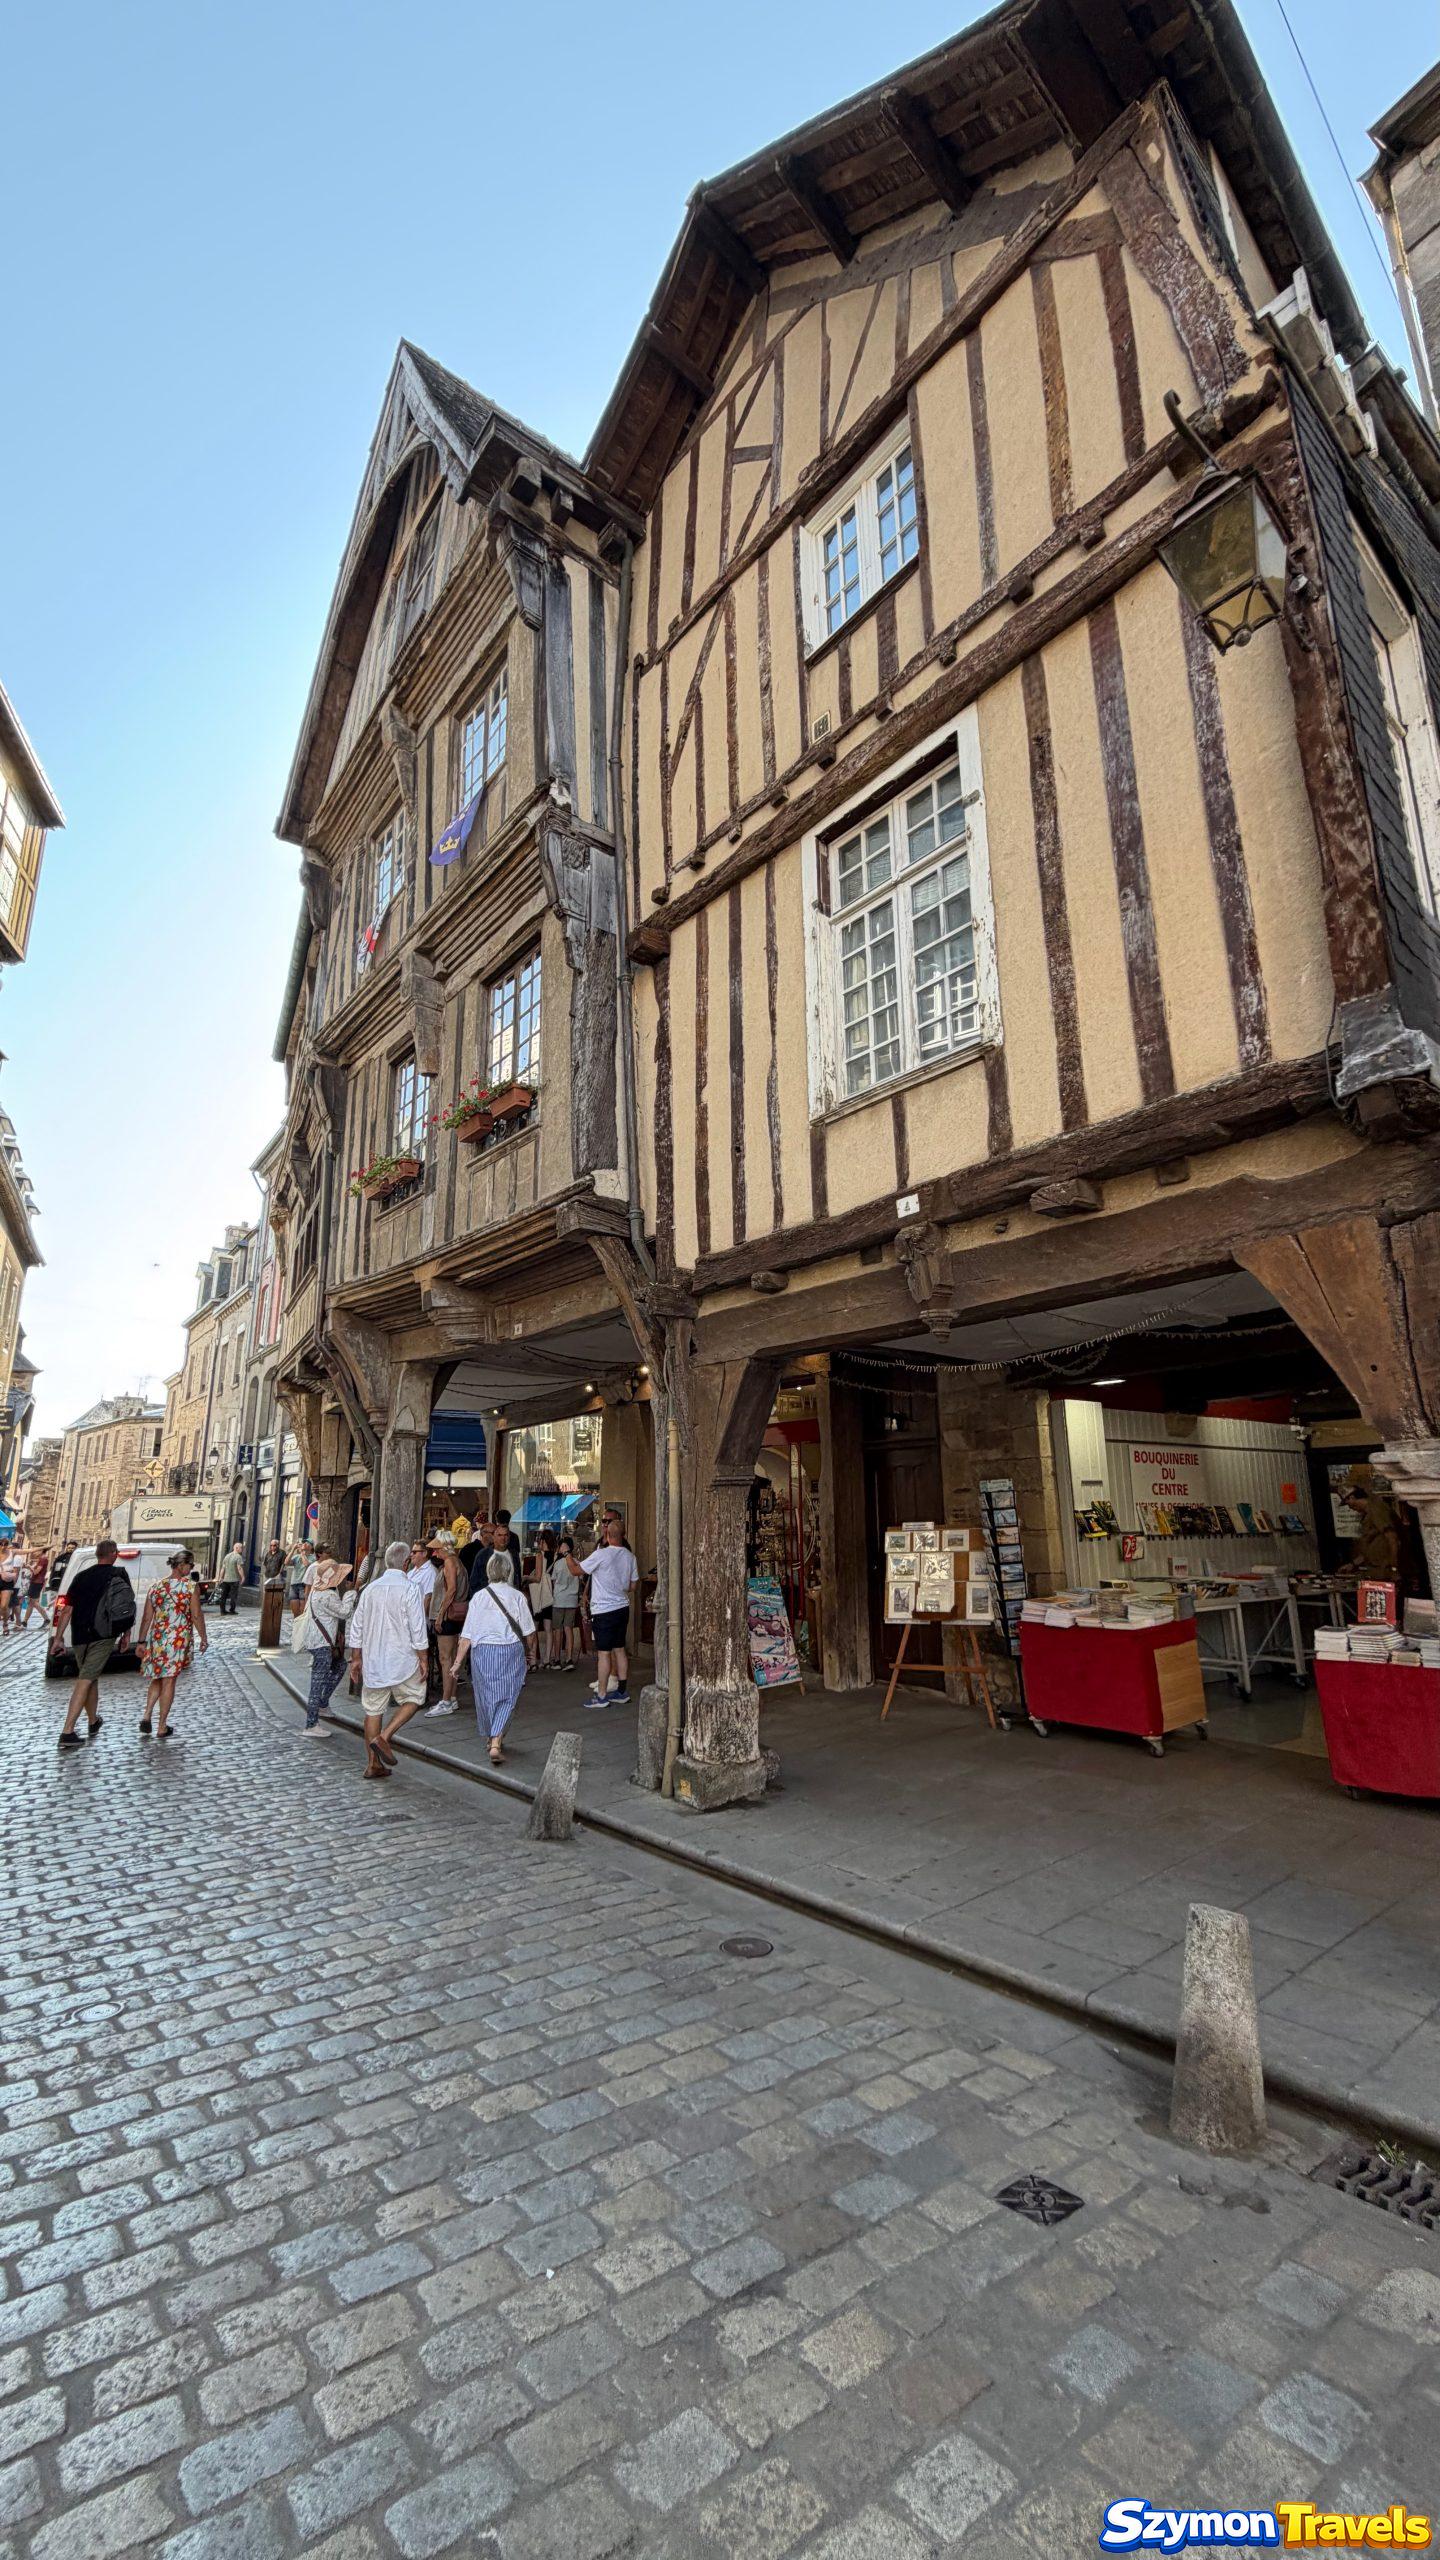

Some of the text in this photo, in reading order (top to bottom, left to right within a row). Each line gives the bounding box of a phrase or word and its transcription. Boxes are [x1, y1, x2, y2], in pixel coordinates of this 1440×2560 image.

[1133, 1450, 1199, 1466] BOUQUINERIE
[1161, 1467, 1176, 1480] DU
[1151, 1482, 1189, 1496] CENTRE
